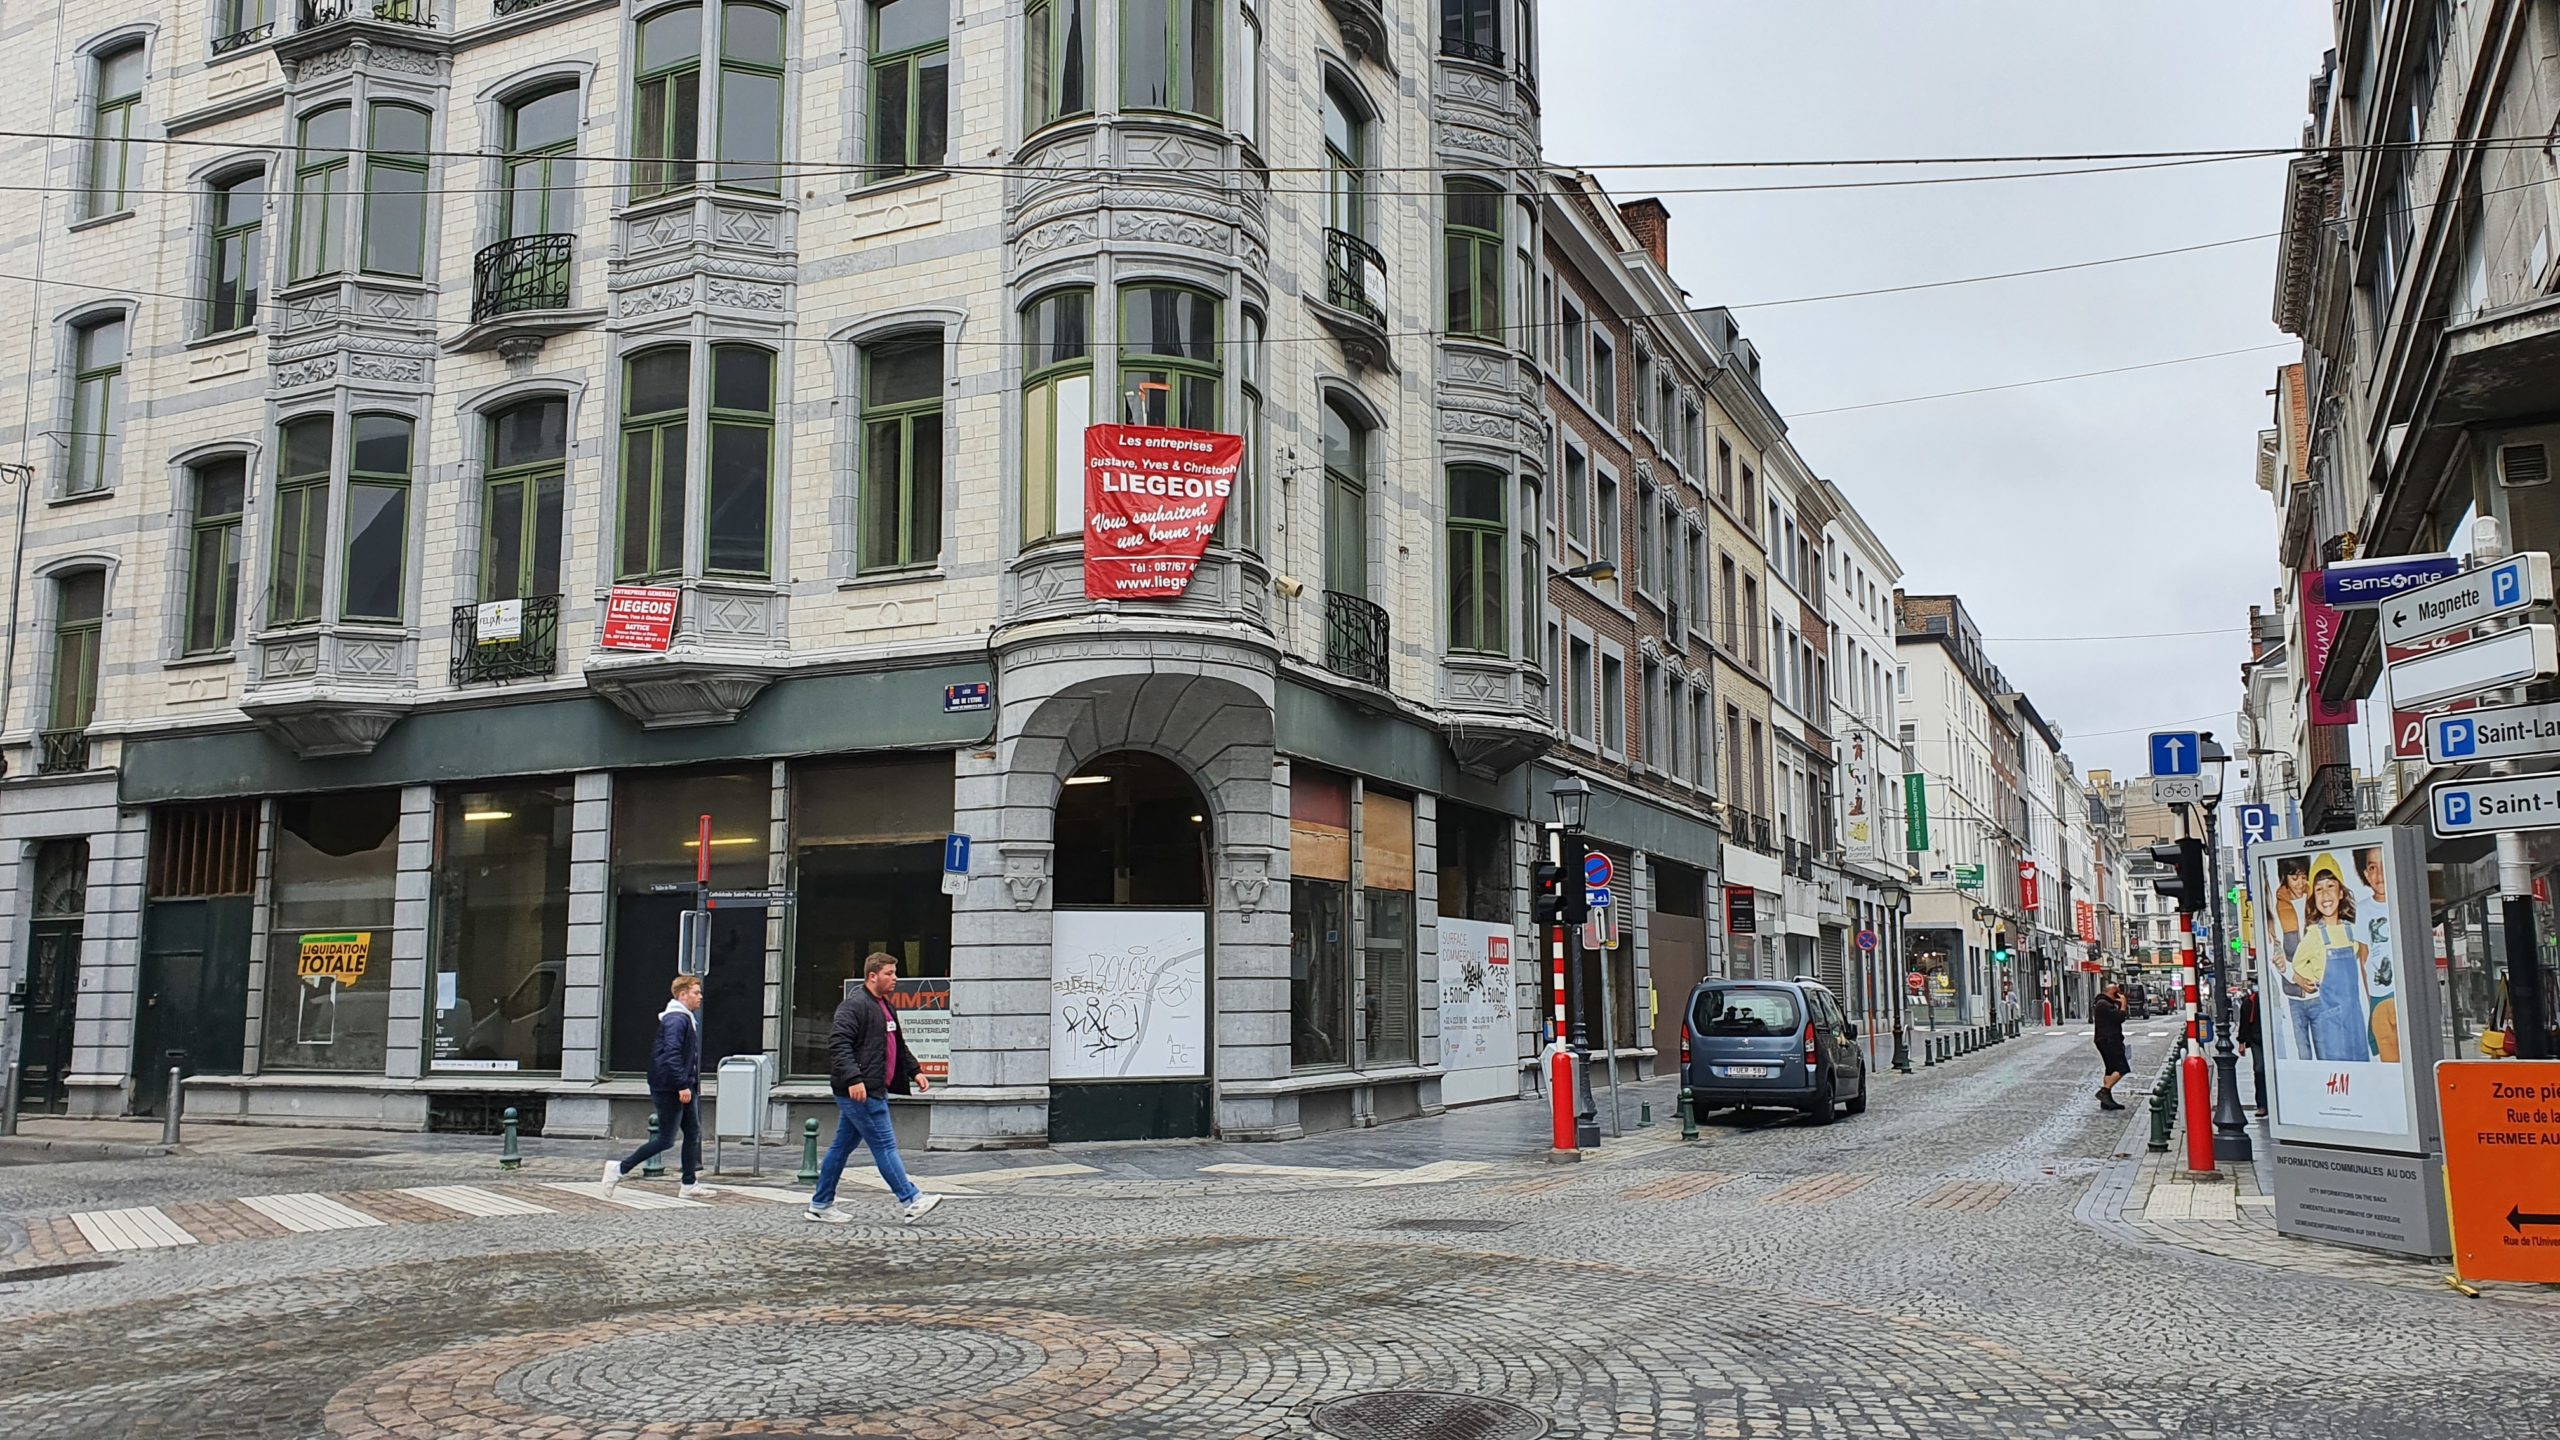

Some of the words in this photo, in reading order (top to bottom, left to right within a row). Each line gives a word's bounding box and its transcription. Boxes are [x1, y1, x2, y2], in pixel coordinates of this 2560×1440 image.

[1119, 434, 1142, 447] Les
[1146, 437, 1213, 453] entreprises
[1091, 457, 1138, 470] Gustave,
[1142, 459, 1168, 471] Yves
[1173, 461, 1180, 471] &
[1103, 472, 1231, 498] LIEGEOIS
[1092, 513, 1128, 533] Vous
[1133, 502, 1208, 524] souhaitent
[1117, 533, 1144, 549] une
[1150, 524, 1190, 542] bonne
[1155, 561, 1186, 573] 087/67
[2339, 572, 2442, 592] Samsonite
[2418, 589, 2480, 622] Magnette
[2497, 572, 2514, 600] P
[612, 599, 672, 615] LIEGEOIS
[2447, 725, 2468, 753] P
[2448, 797, 2467, 821] P
[2479, 790, 2560, 816] Saint-
[1443, 931, 1468, 947] SURFACE
[303, 943, 367, 955] LIQUIDATION
[302, 955, 366, 973] TOTALE
[2326, 1072, 2350, 1096] H&M
[2492, 1082, 2536, 1099] Zone
[2507, 1108, 2530, 1123] Rue
[2534, 1108, 2548, 1123] de
[2477, 1132, 2537, 1145] FERMEE
[2277, 1155, 2329, 1171] INFORMATIONS
[2331, 1162, 2384, 1177] COMMUNALES
[2387, 1168, 2398, 1178] AU
[2400, 1169, 2417, 1181] DOS
[2503, 1235, 2519, 1246] Rue
[2521, 1236, 2531, 1246] de
